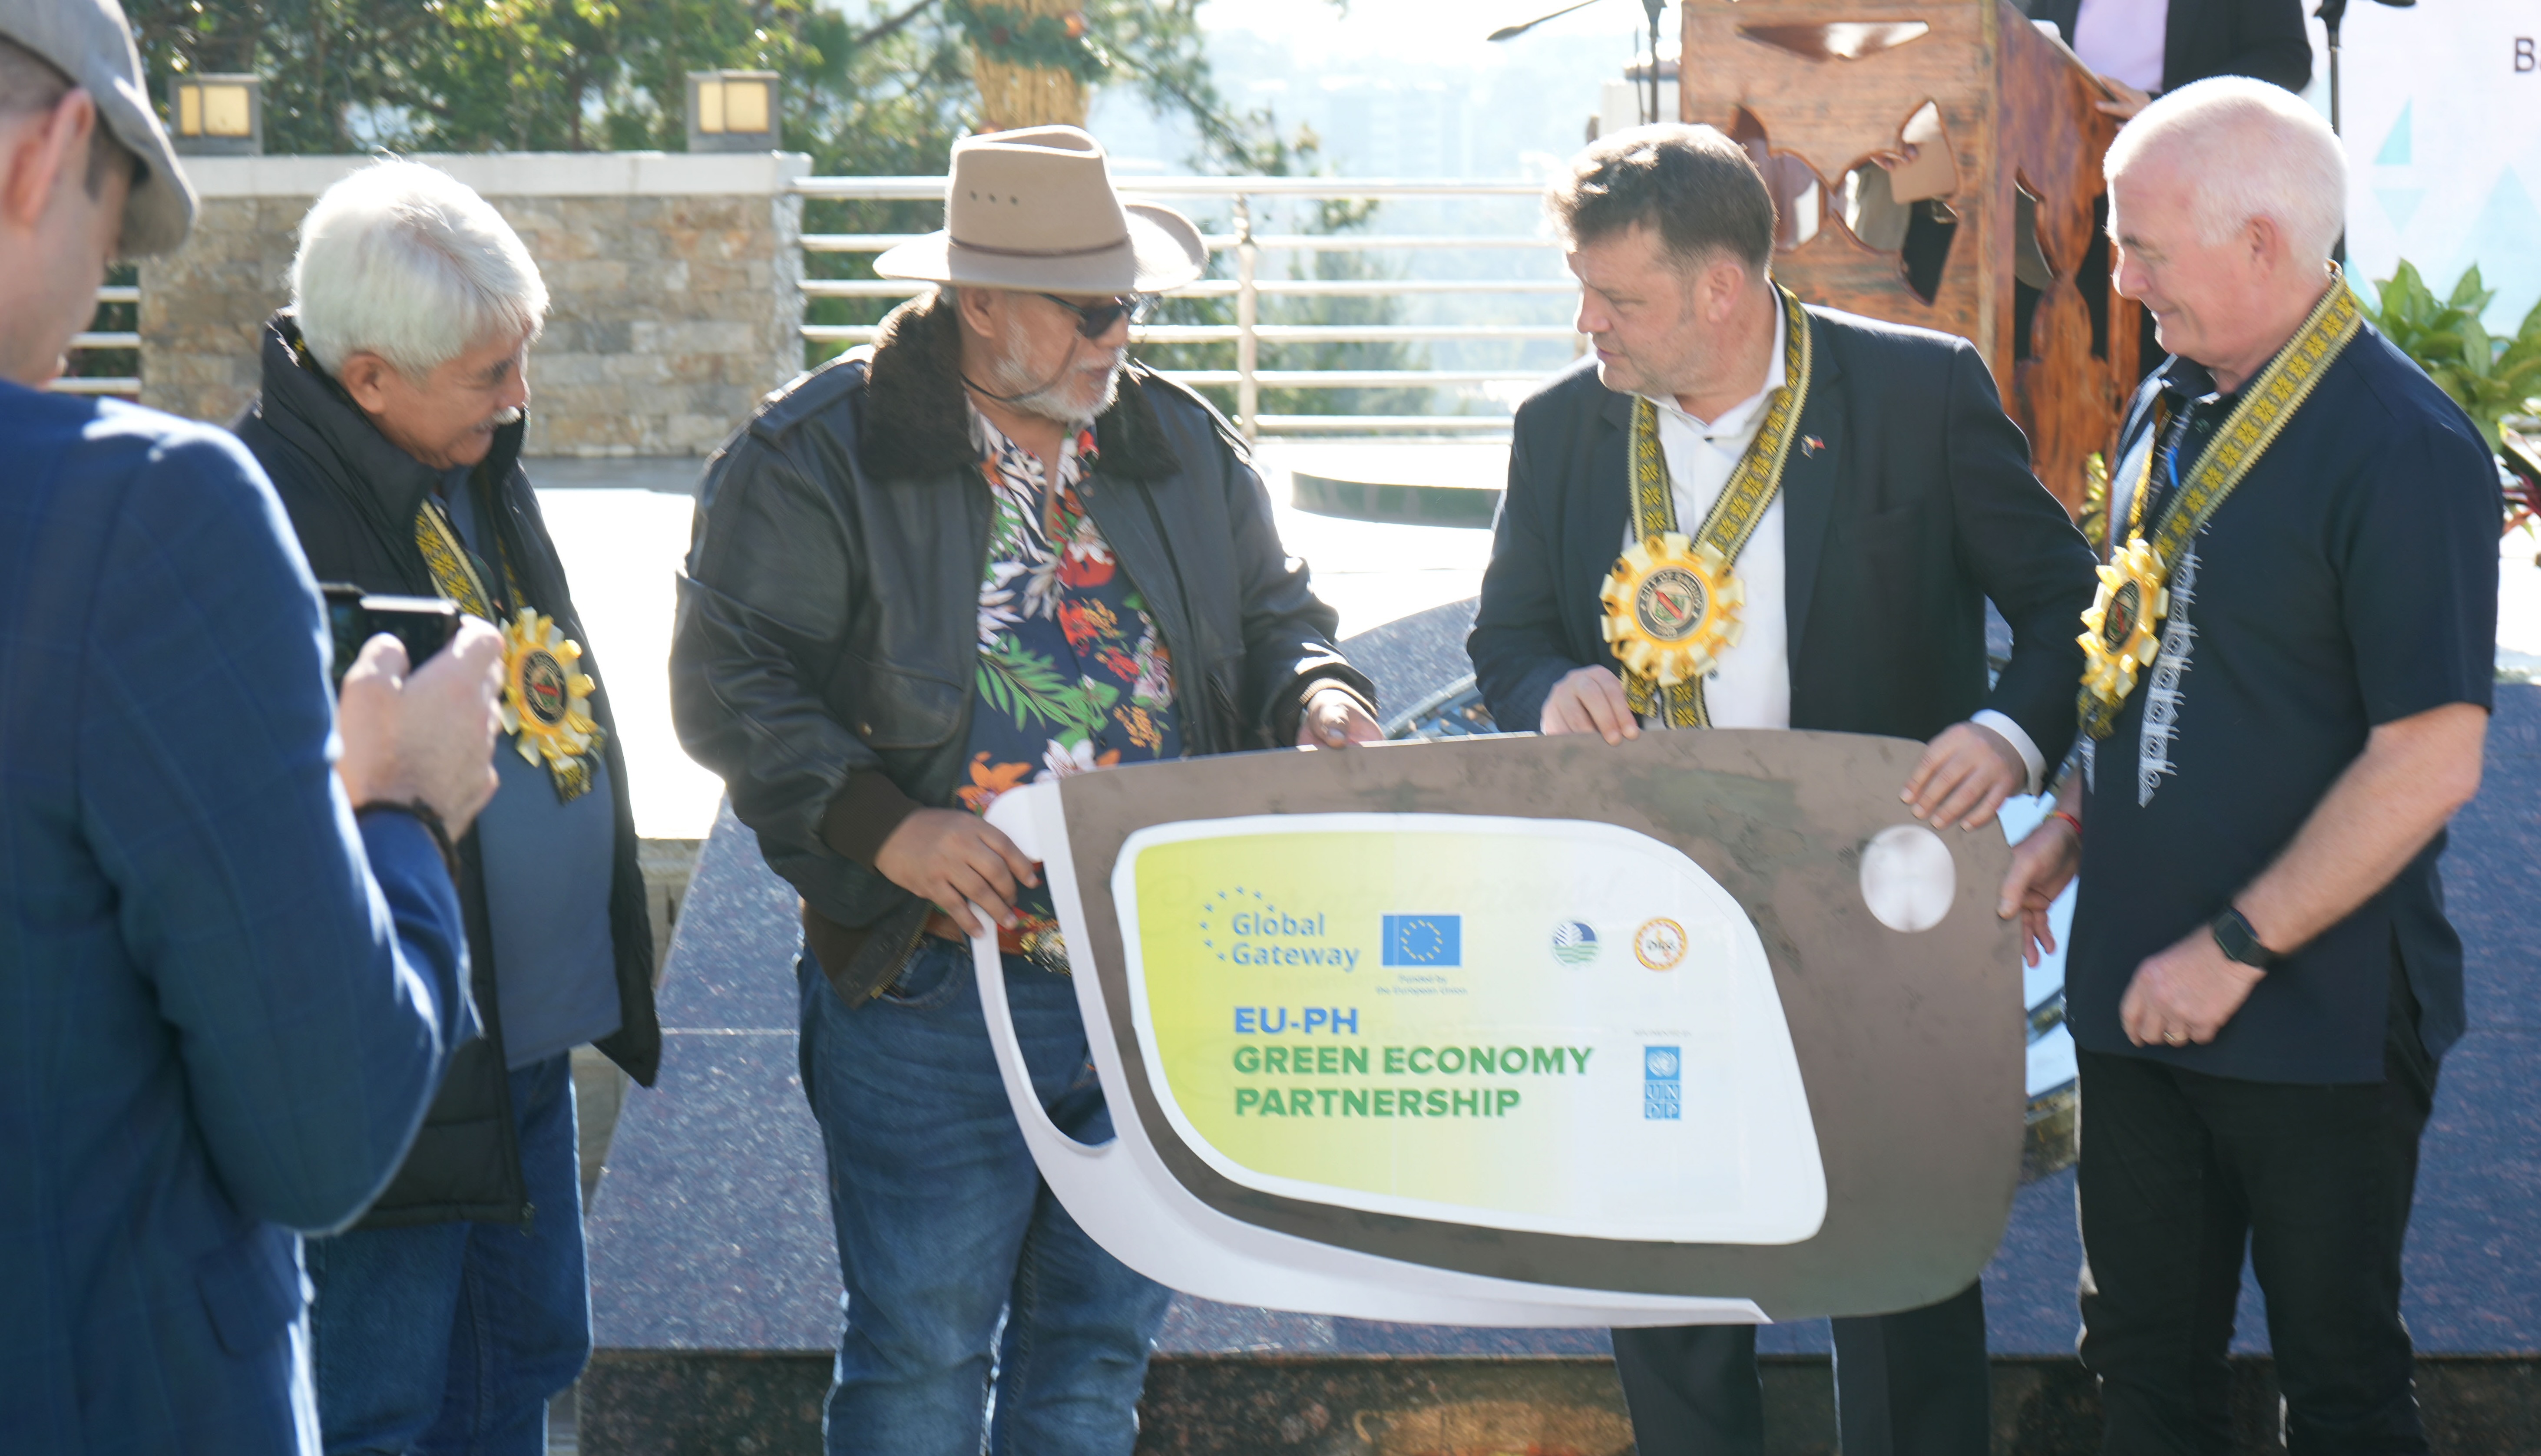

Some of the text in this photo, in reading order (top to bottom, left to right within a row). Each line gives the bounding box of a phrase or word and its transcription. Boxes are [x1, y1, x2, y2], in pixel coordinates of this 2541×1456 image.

[2515, 37, 2541, 72] B
[1232, 912, 1325, 937] Global
[1232, 941, 1361, 973] Gateway
[1234, 1006, 1359, 1034] EU-PH
[1234, 1046, 1595, 1075] GREEN ECONOMY
[1235, 1087, 1522, 1117] PARTNERSHIP
